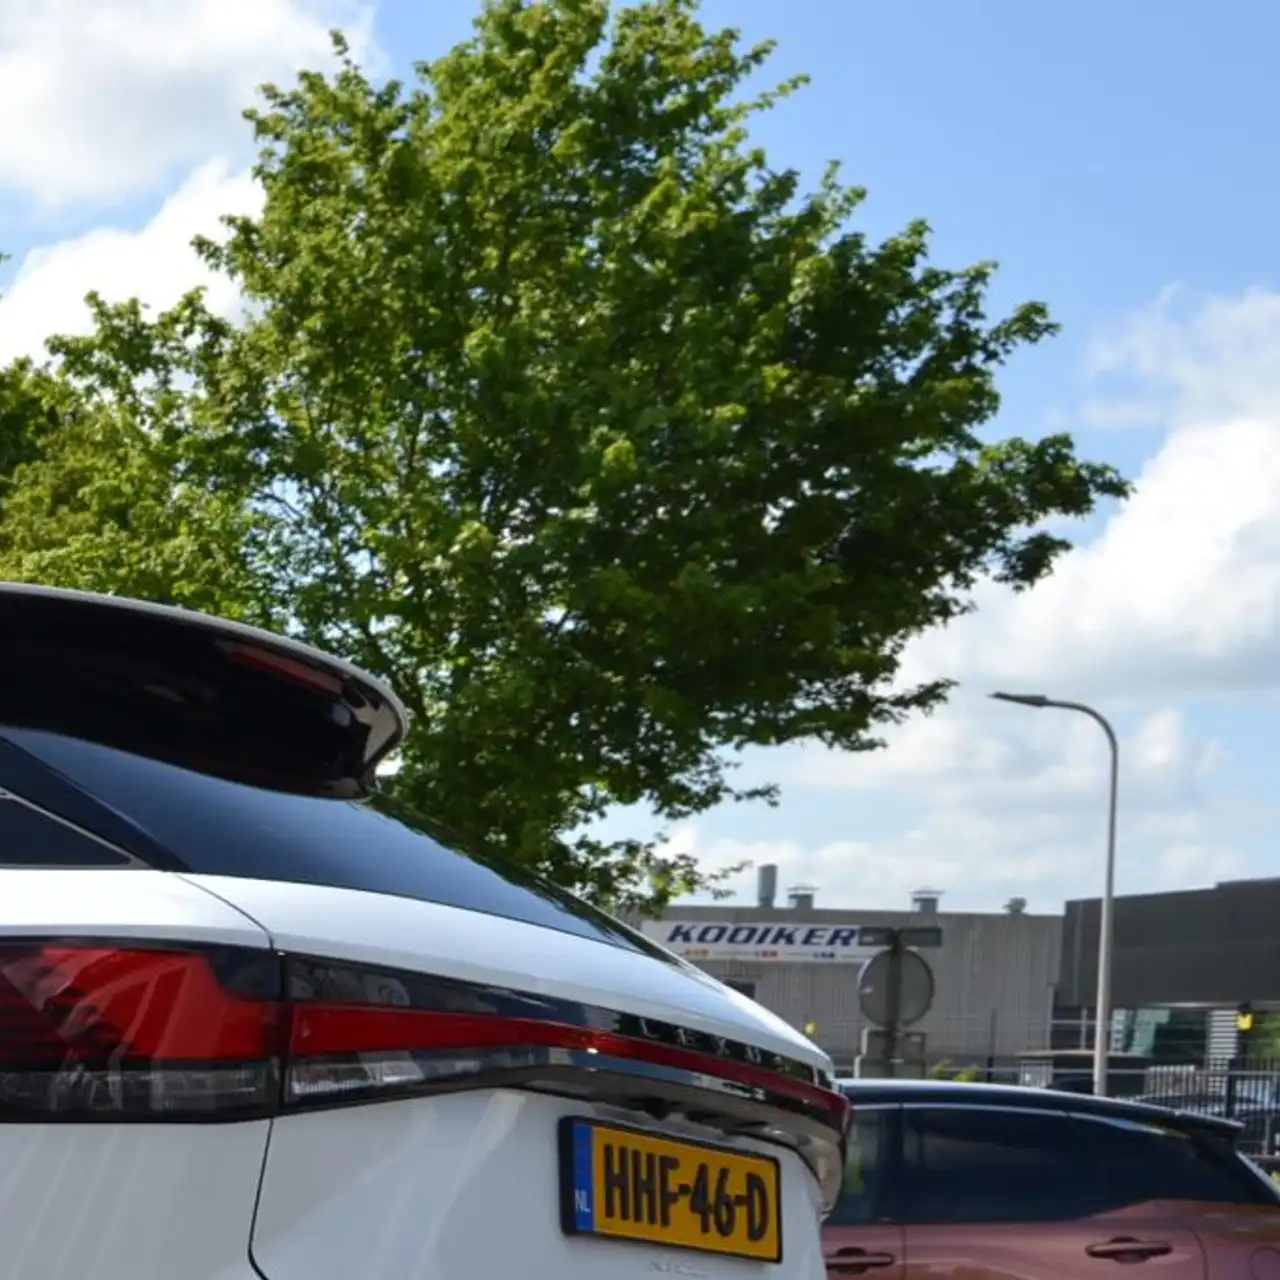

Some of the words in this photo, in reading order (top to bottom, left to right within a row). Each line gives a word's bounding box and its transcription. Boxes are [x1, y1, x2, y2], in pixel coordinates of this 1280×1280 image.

[666, 924, 859, 946] KOOIKER
[574, 1188, 591, 1214] NL
[603, 1143, 769, 1243] HHF-46-D
